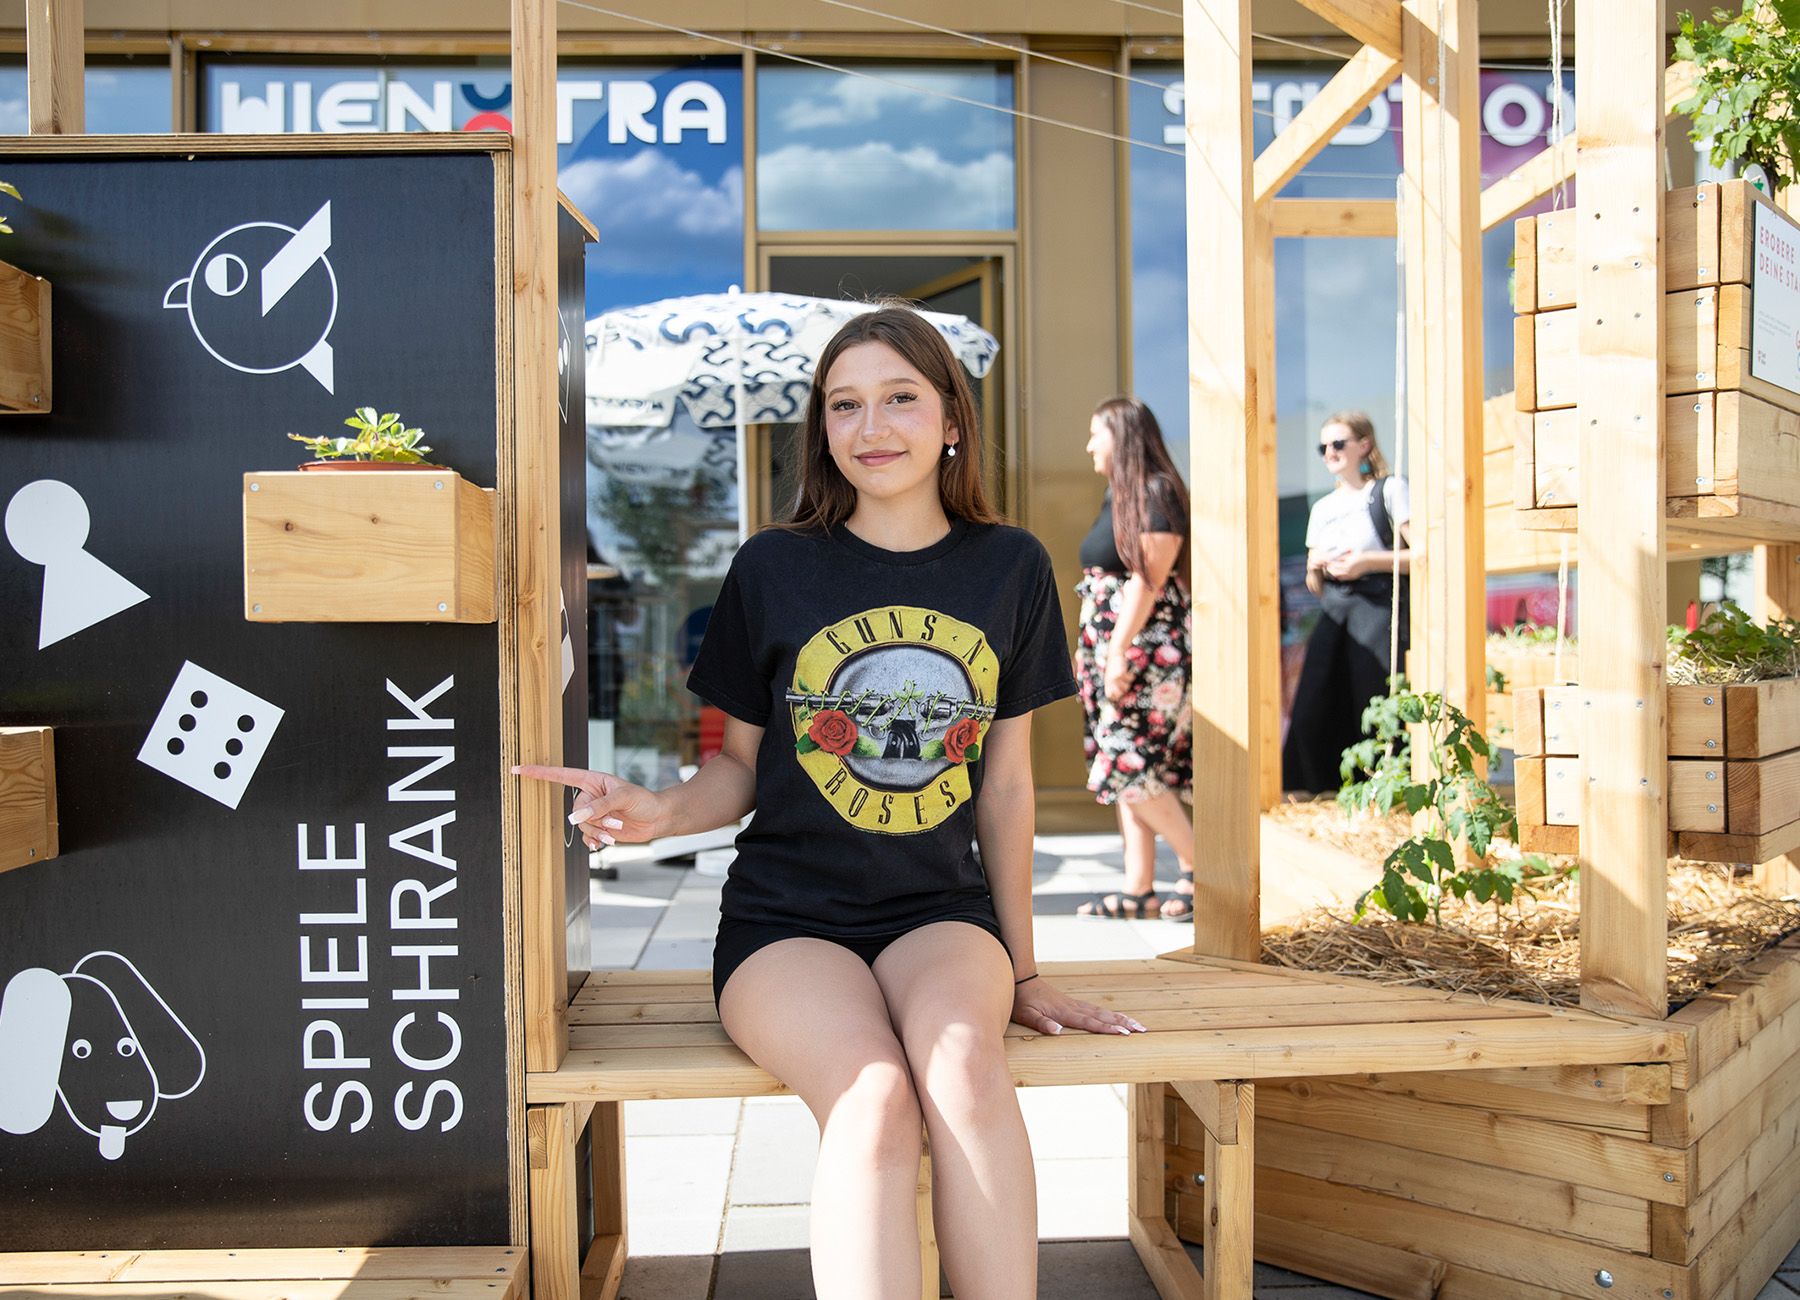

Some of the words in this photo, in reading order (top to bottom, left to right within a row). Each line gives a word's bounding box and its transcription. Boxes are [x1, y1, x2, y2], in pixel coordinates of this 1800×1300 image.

[1760, 225, 1795, 265] EROBERE
[1760, 253, 1783, 283] DEINE
[1786, 270, 1800, 292] STA
[825, 610, 938, 655] GUNS
[824, 767, 957, 825] ROSES
[386, 674, 464, 1133] SCHRANK
[298, 823, 373, 1133] SPIELE
